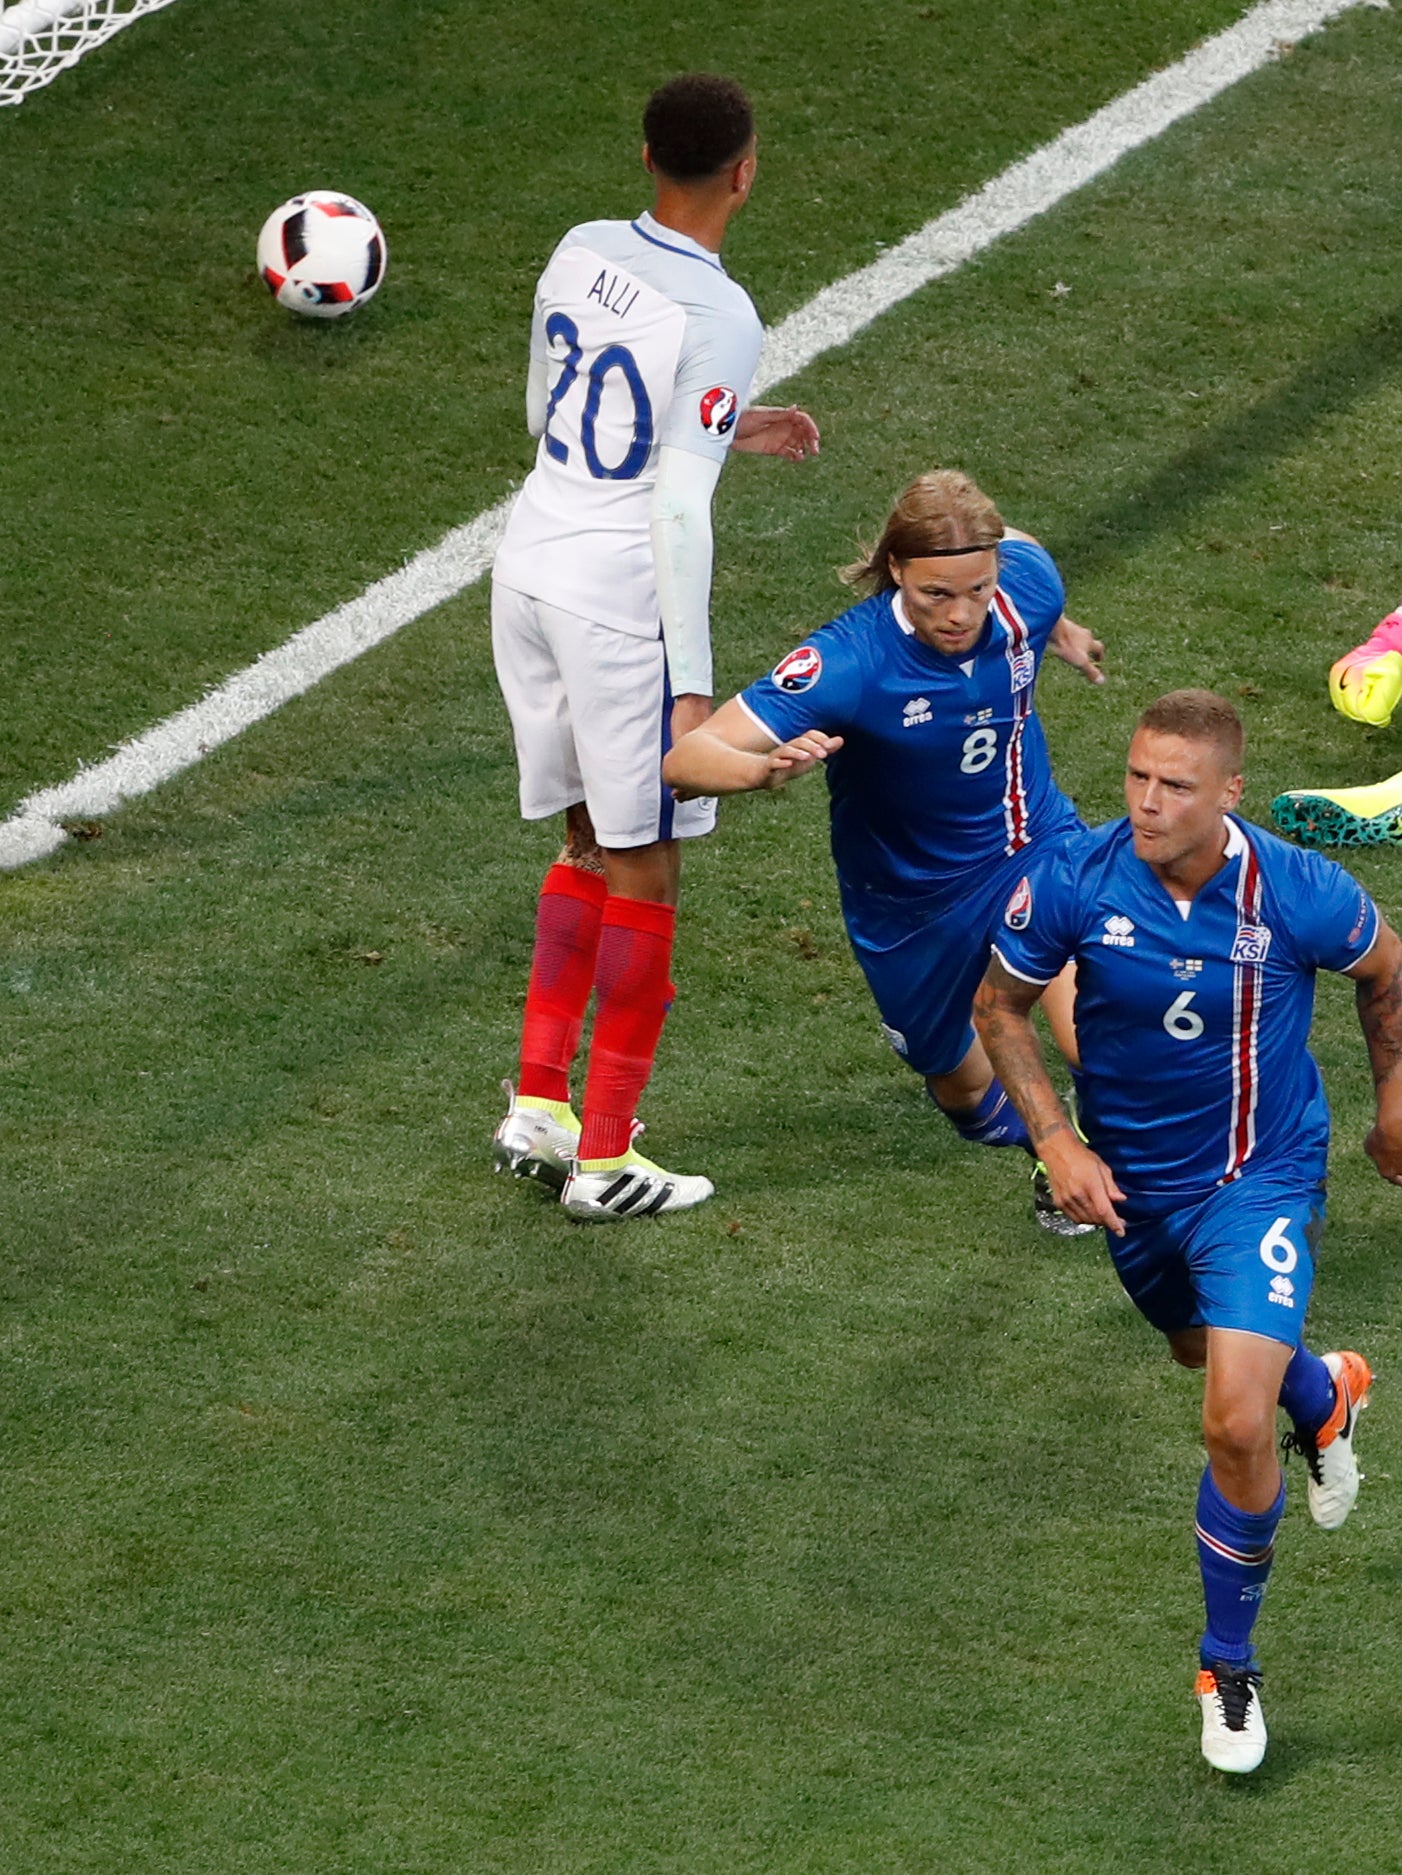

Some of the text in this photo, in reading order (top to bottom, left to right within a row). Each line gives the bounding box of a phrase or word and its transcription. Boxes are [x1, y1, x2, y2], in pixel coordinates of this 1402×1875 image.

[586, 269, 640, 318] ALLI
[546, 312, 654, 480] 20
[960, 728, 998, 774] 8
[1163, 991, 1204, 1040] 6
[1260, 1217, 1298, 1274] 6
